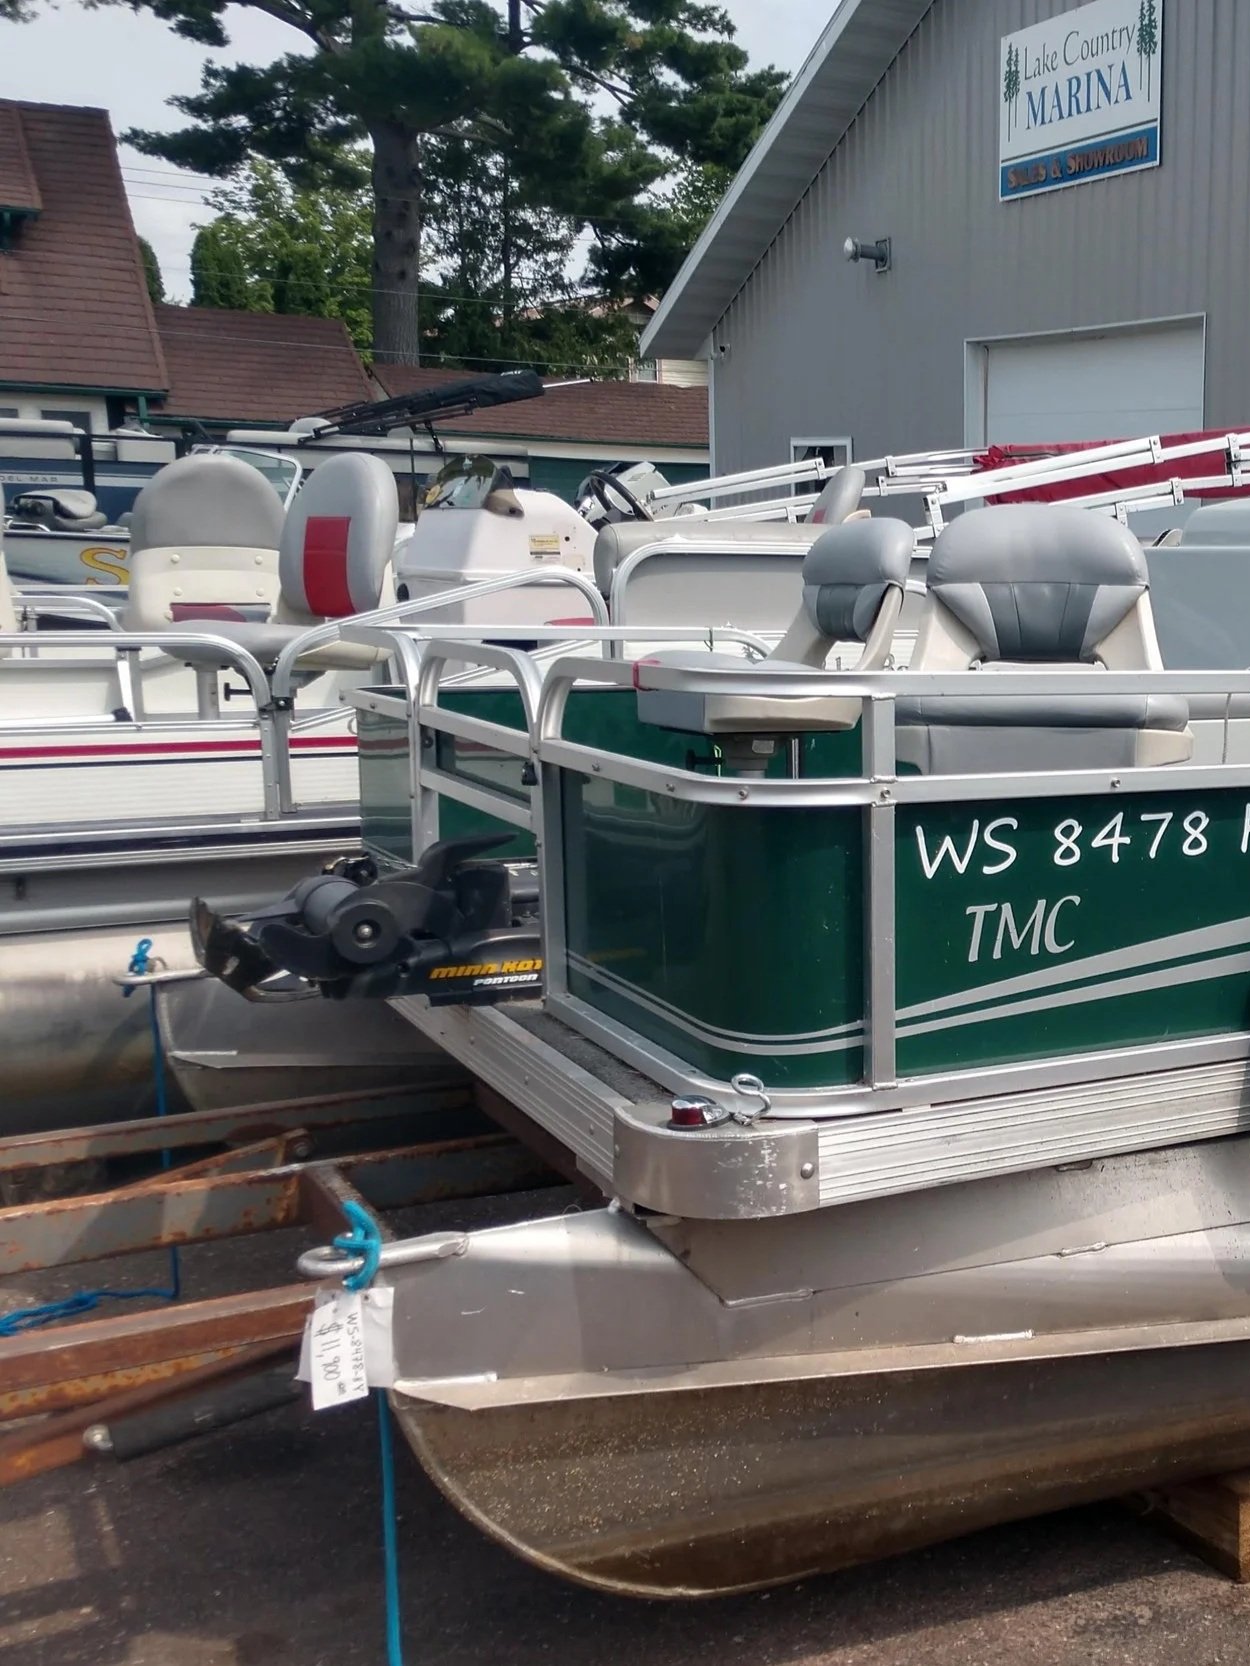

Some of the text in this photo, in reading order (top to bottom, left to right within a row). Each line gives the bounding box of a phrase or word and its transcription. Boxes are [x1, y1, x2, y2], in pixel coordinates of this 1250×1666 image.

[1024, 23, 1136, 81] Lake Country
[1025, 59, 1133, 130] MARINA
[1051, 157, 1063, 180] &
[915, 816, 1019, 880] WS
[1052, 809, 1210, 867] 8478
[965, 895, 1081, 962] TMC
